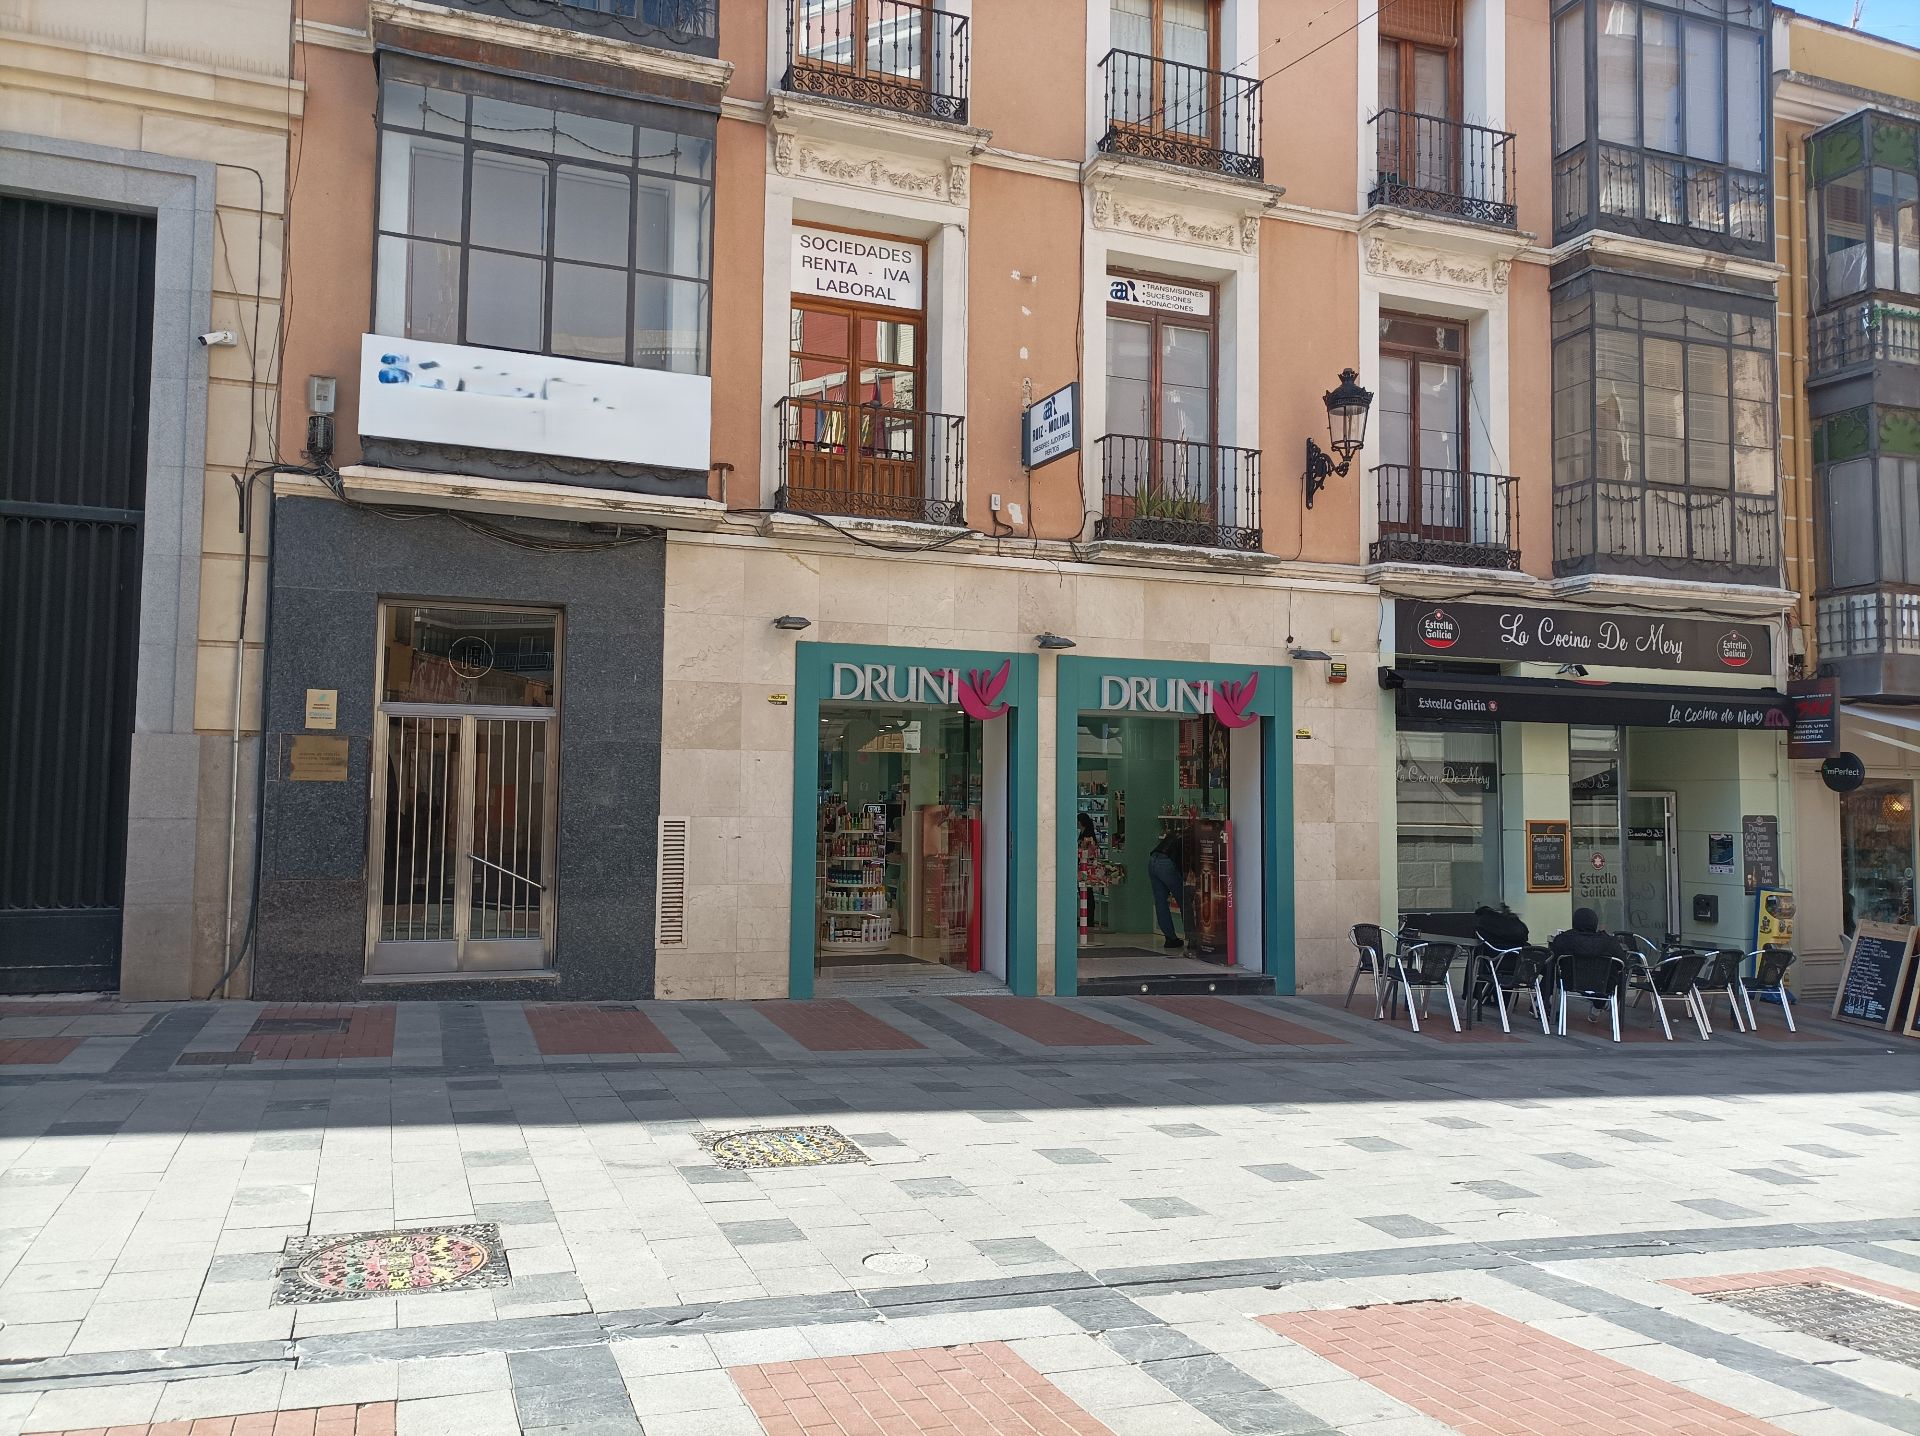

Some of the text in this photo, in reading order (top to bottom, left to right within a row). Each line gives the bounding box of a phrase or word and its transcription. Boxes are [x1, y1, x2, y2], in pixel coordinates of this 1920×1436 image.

[800, 234, 912, 264] SOCIEDADES
[802, 255, 858, 276] RENTA
[884, 267, 911, 284] IVA
[816, 277, 896, 301] LABORAL
[1146, 283, 1204, 298] TRANSMISIONES
[1146, 291, 1192, 304] SUCESIONES
[1146, 299, 1194, 312] DONACIONES
[1032, 425, 1044, 442] RUIZ
[1049, 412, 1070, 434] MOLINA
[1424, 619, 1453, 631] Estrella
[1425, 629, 1452, 640] Galicia
[1500, 613, 1683, 664] La Cocina De Mery
[1722, 640, 1747, 650] Estrella
[1723, 649, 1746, 658] Galicia
[832, 662, 960, 705] DRUNI
[1100, 675, 1215, 715] DRUNI
[1418, 697, 1487, 711] Estrella Galicia
[1667, 704, 1763, 726] La Cocina de Mery
[1827, 767, 1860, 776] mPerfect
[1579, 872, 1617, 885] Estrella
[1580, 884, 1616, 898] Galicia
